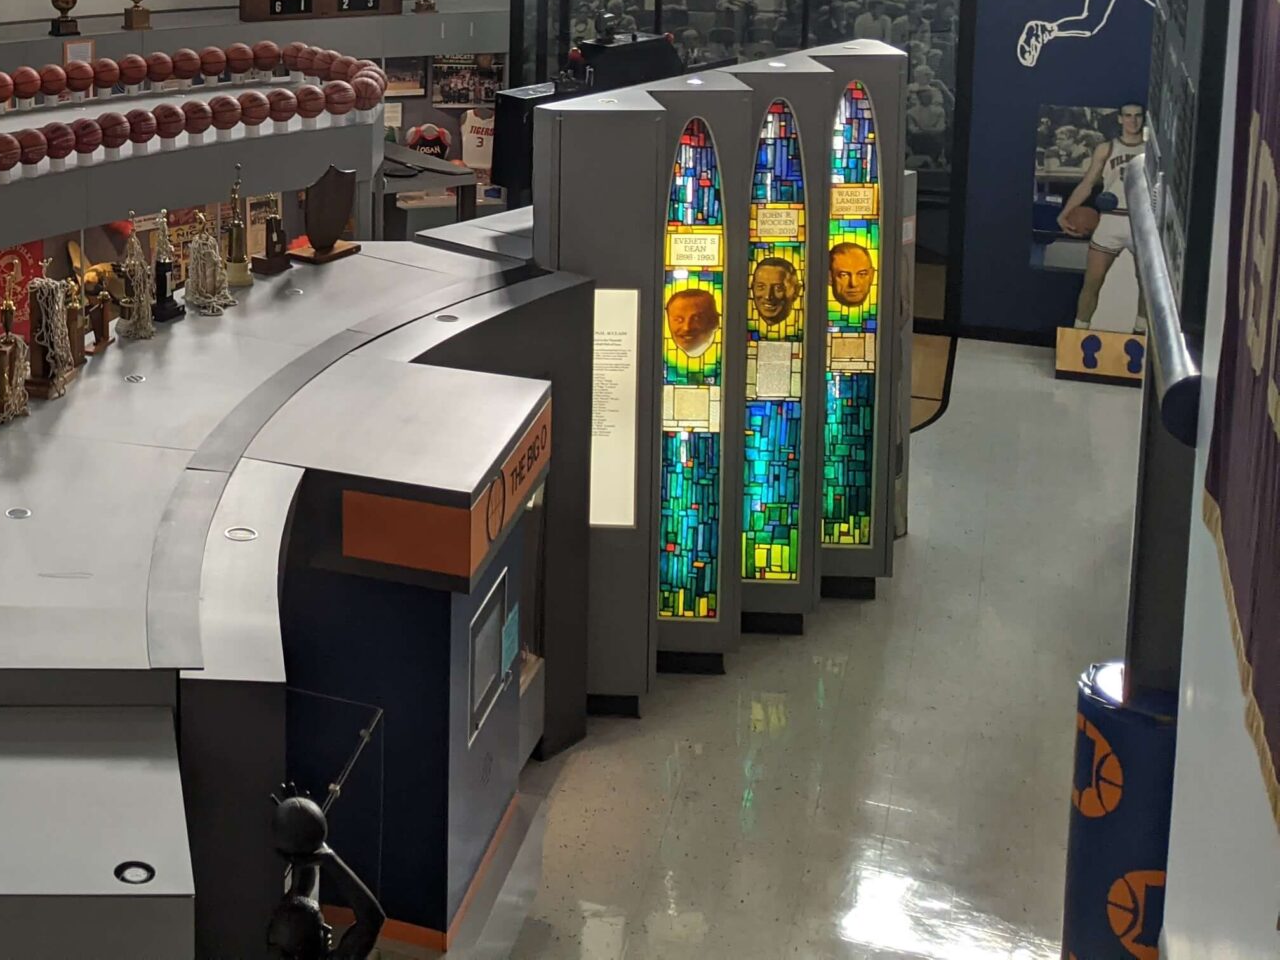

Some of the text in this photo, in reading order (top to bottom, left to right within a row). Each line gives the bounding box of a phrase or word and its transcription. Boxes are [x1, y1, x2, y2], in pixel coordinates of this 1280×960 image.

[476, 137, 484, 147] 3
[510, 424, 547, 495] THE BIG O
